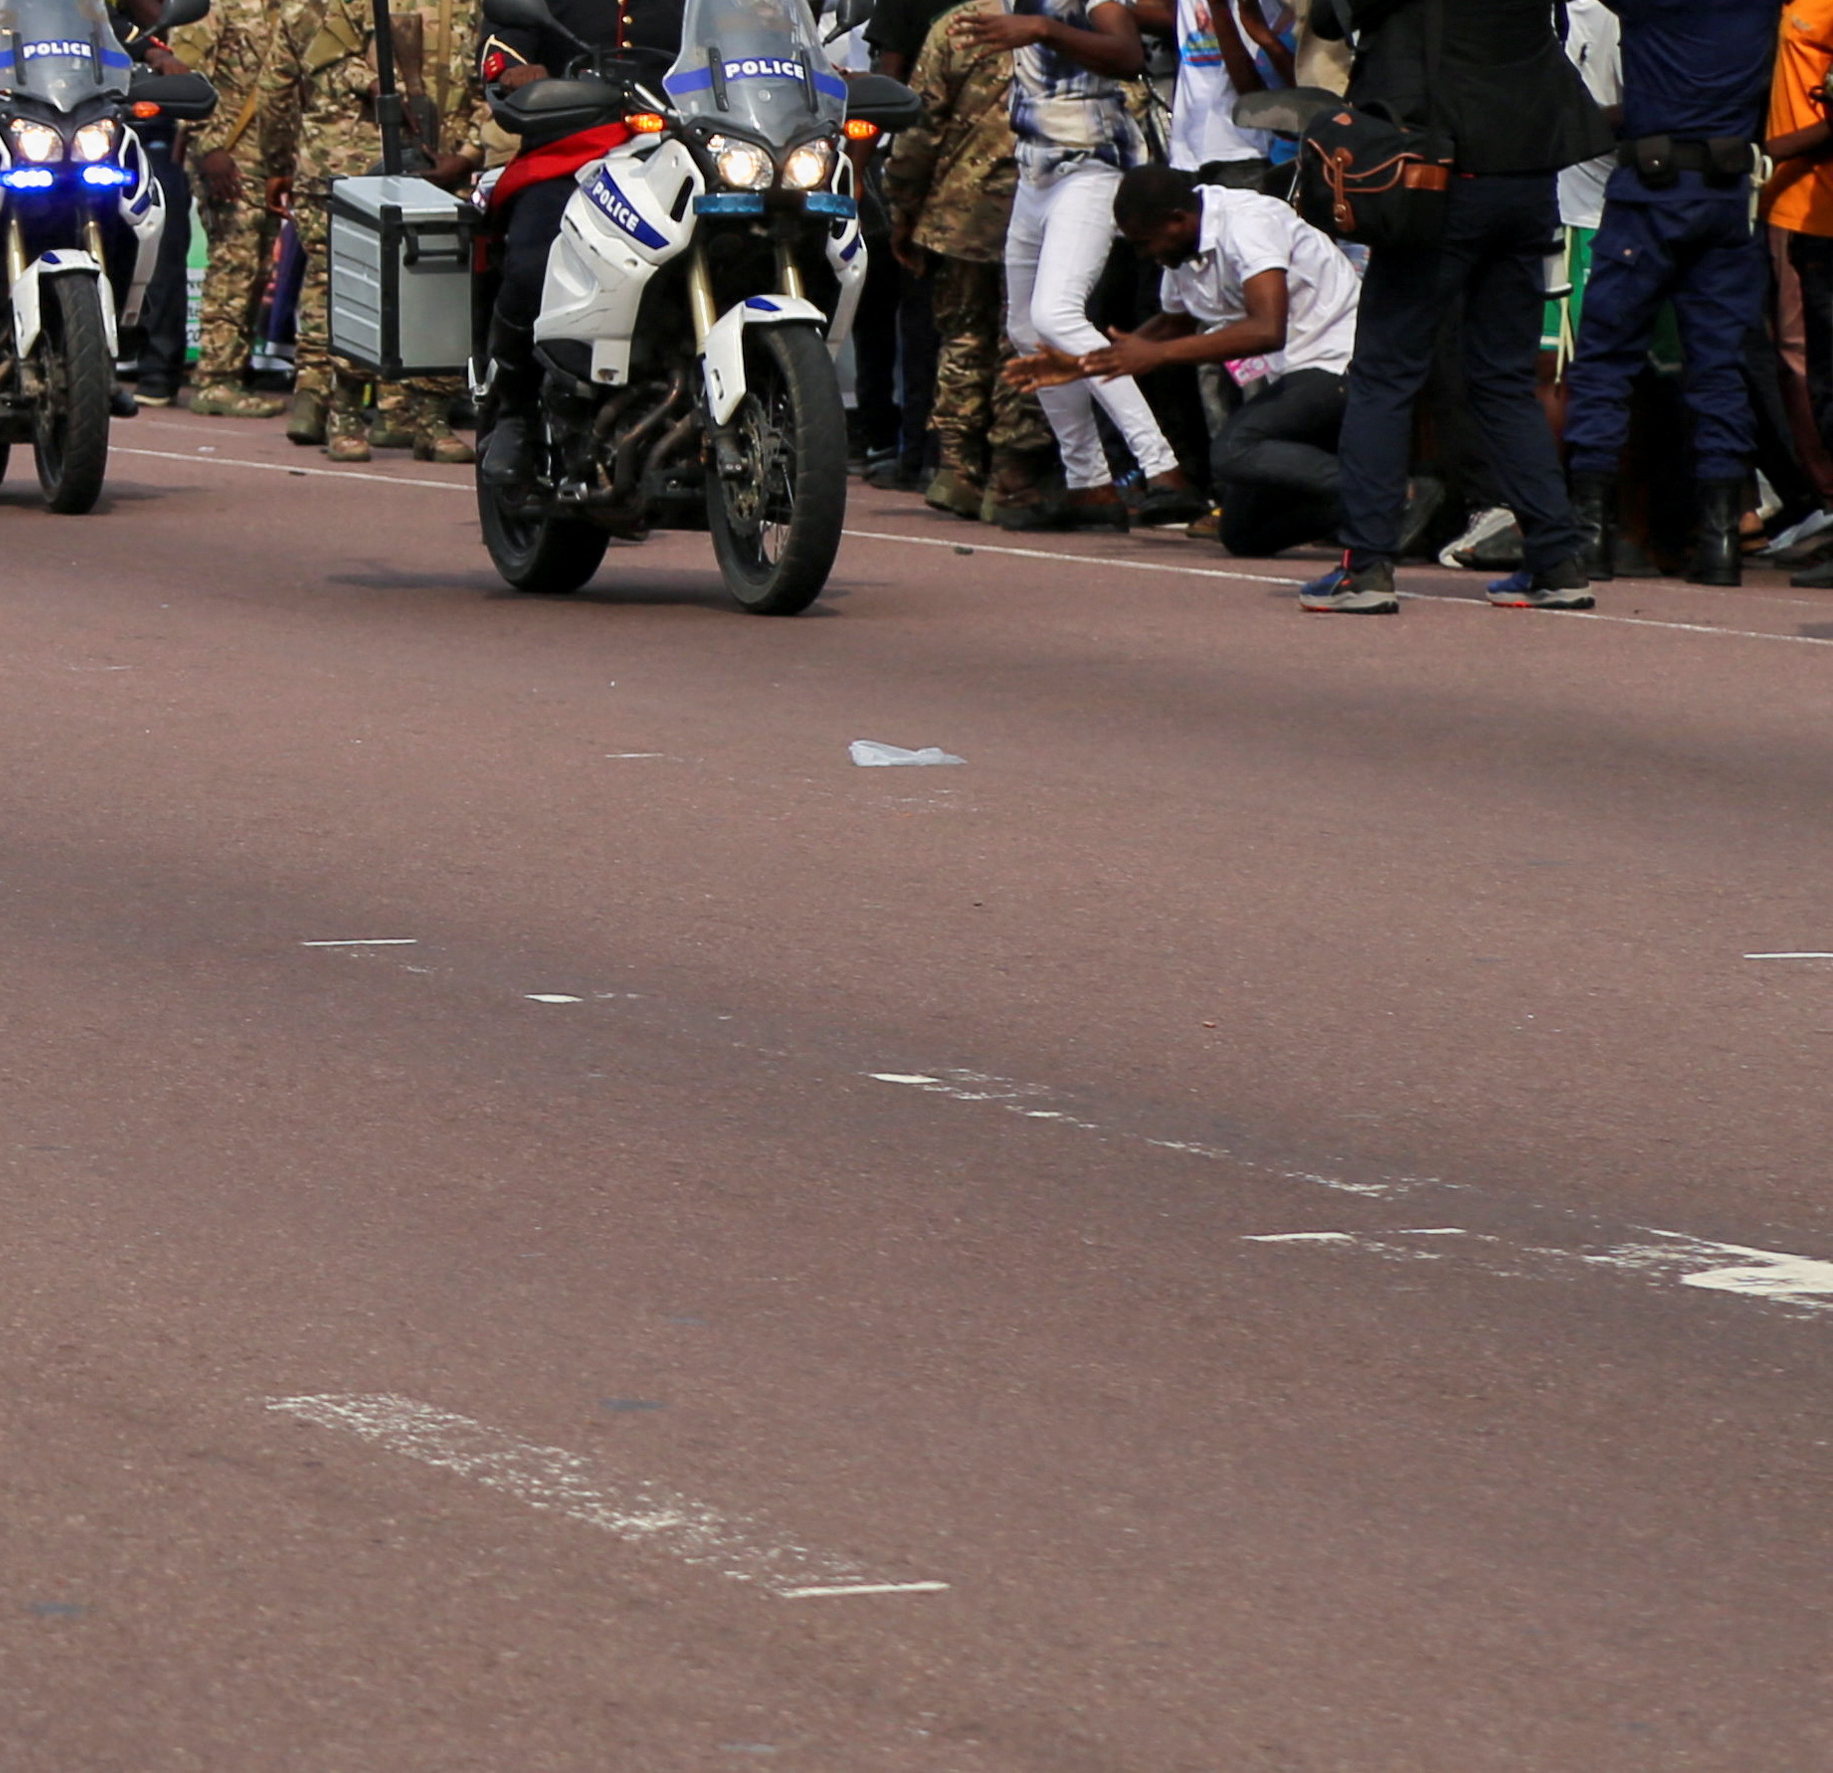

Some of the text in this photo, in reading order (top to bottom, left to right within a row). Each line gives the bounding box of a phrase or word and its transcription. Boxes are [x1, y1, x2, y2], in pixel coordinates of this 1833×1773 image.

[21, 42, 93, 60] POLICE
[724, 58, 806, 81] POLICE
[591, 178, 640, 233] POLICE
